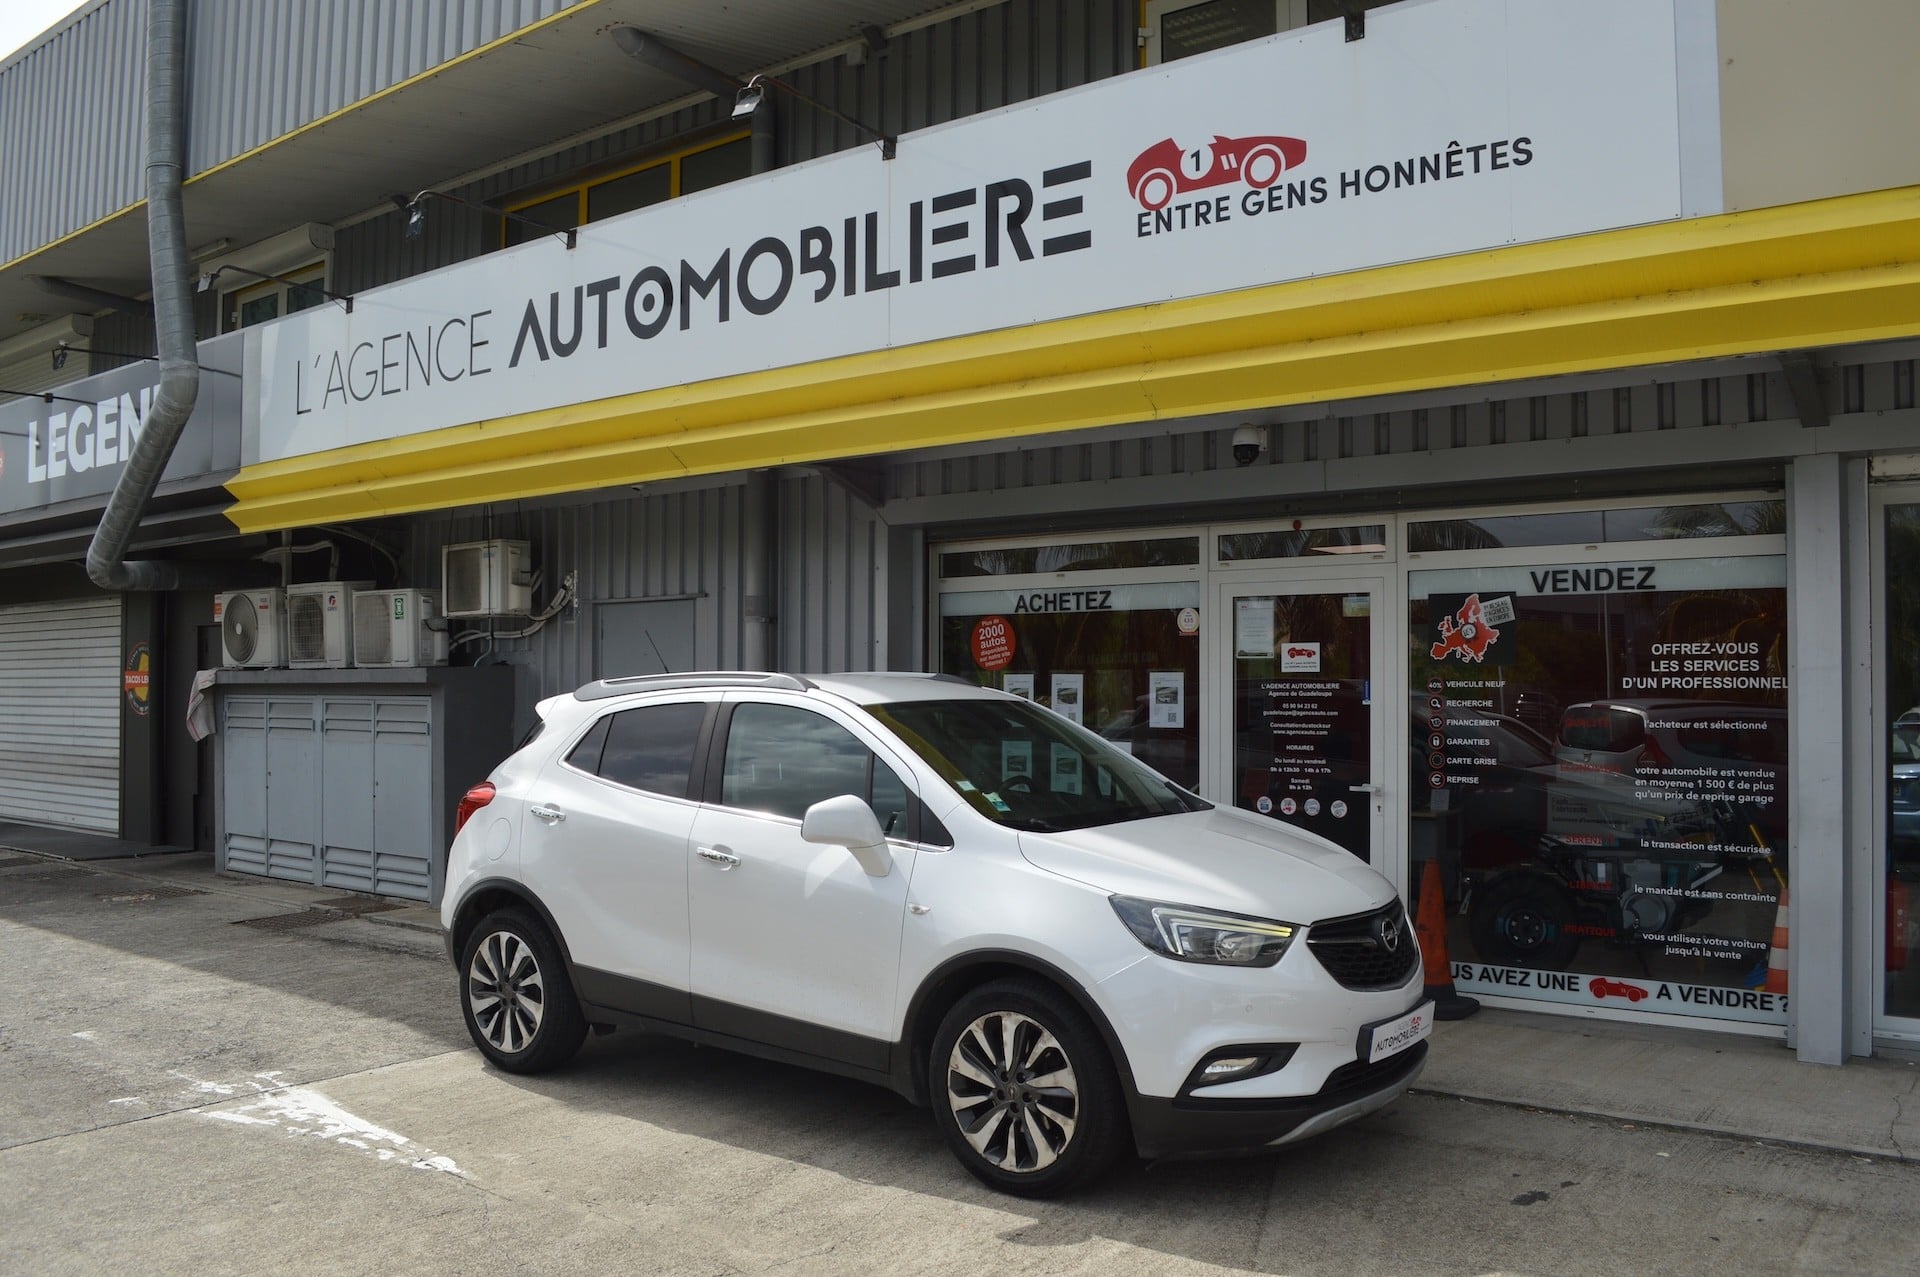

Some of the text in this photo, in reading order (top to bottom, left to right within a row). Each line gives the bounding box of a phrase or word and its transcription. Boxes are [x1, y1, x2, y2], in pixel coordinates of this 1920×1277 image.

[1190, 148, 1201, 172] 1
[1137, 136, 1533, 238] ENTRE GENS HONNÊTES
[296, 160, 1092, 415] L'AGENCE AUTOMOBILIERE
[28, 384, 160, 483] LEGEN
[1530, 566, 1656, 593] VENDEZ
[1014, 590, 1112, 613] ACHETEZ
[979, 624, 1004, 640] 2000
[980, 635, 1006, 649] autos
[1651, 642, 1759, 655] OFFREZ-VOUS
[1651, 659, 1760, 672] LES SERVICES
[1622, 676, 1788, 689] D'UN PROFESSIONNEL
[1446, 719, 1500, 727] FINANCEMENT
[1644, 719, 1767, 730] l'acheteur est sélectionné
[1446, 738, 1490, 746] GARANTIES
[1447, 776, 1479, 784] REPRISE
[1635, 767, 1775, 778] votre automobile est vendue
[1649, 779, 1694, 789] moyenne
[1697, 780, 1702, 788] 1
[1705, 780, 1725, 789] 500
[1728, 780, 1735, 789] €
[1737, 780, 1750, 790] de
[1753, 781, 1774, 792] plus
[1635, 790, 1773, 804] qu'un prix de reprise garage
[1640, 838, 1649, 847] la
[1652, 839, 1705, 851] transaction
[1707, 843, 1721, 851] est
[1724, 843, 1771, 854] sécurisée
[1634, 884, 1643, 893] le
[1646, 885, 1682, 896] mandat
[1685, 889, 1699, 897] est
[1701, 890, 1723, 899] sans
[1726, 891, 1776, 903] contrainte
[1643, 932, 1767, 950] vous utilisez votre voiture
[1665, 945, 1742, 960] jusqu'à la vente
[1478, 967, 1530, 987] AVEZ
[1537, 972, 1580, 991] UNE
[1656, 983, 1672, 1001] A
